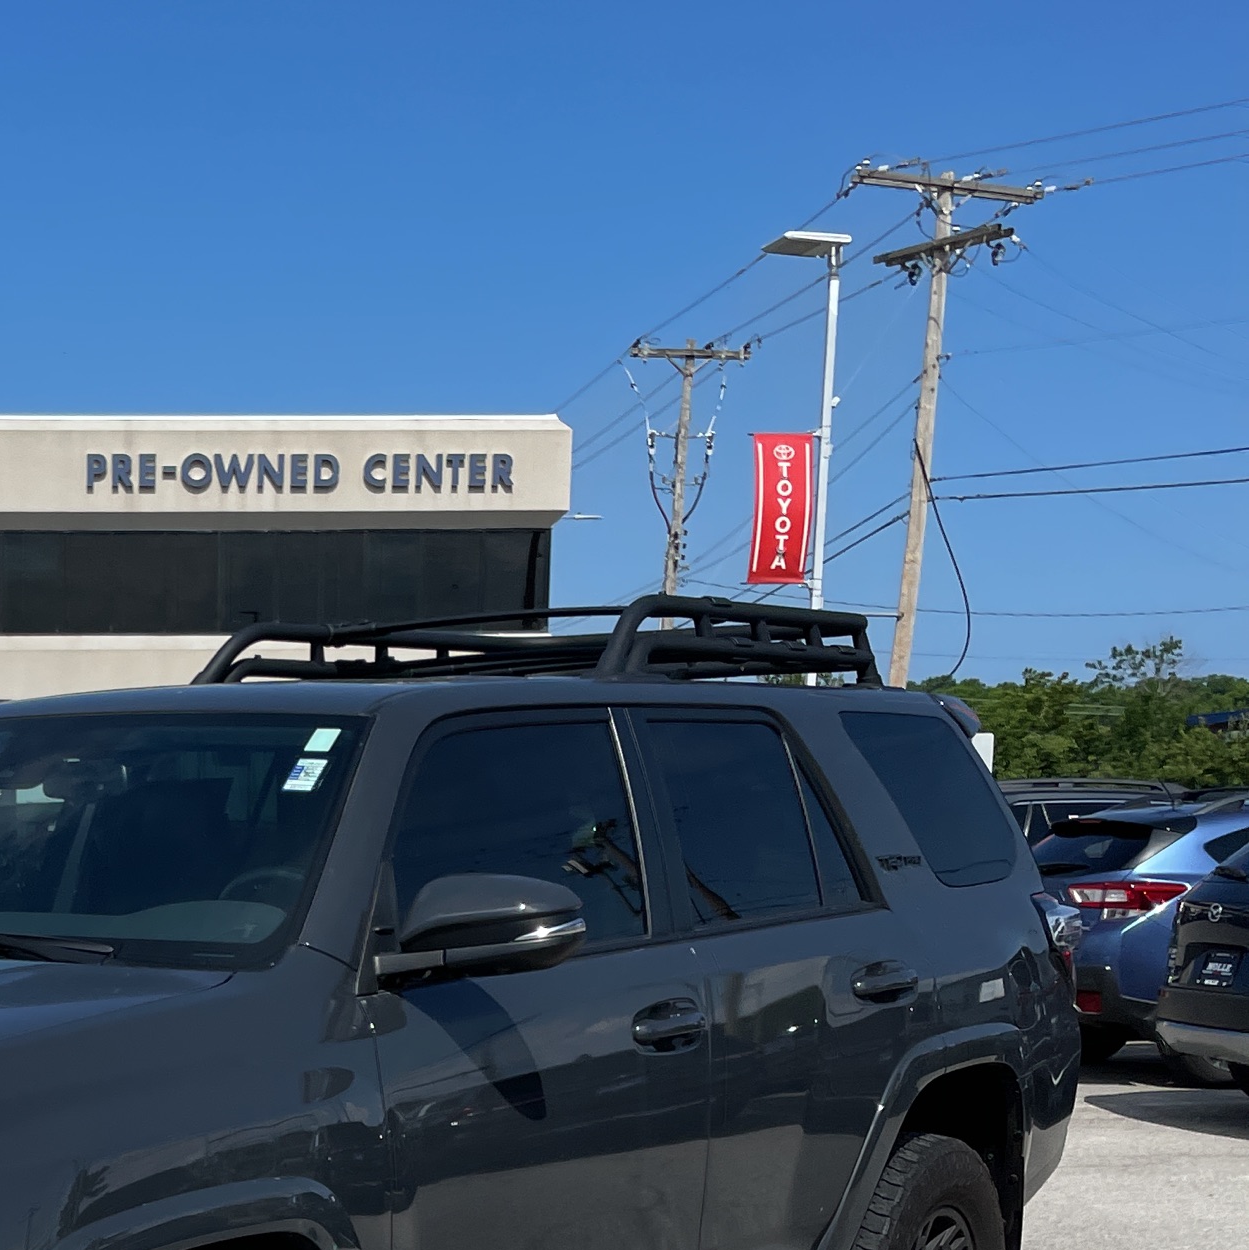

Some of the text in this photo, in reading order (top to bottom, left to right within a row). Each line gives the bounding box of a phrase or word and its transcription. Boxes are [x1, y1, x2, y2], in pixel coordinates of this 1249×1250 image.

[86, 452, 515, 494] PRE-OWNED CENTER
[770, 461, 793, 570] TOYOTA
